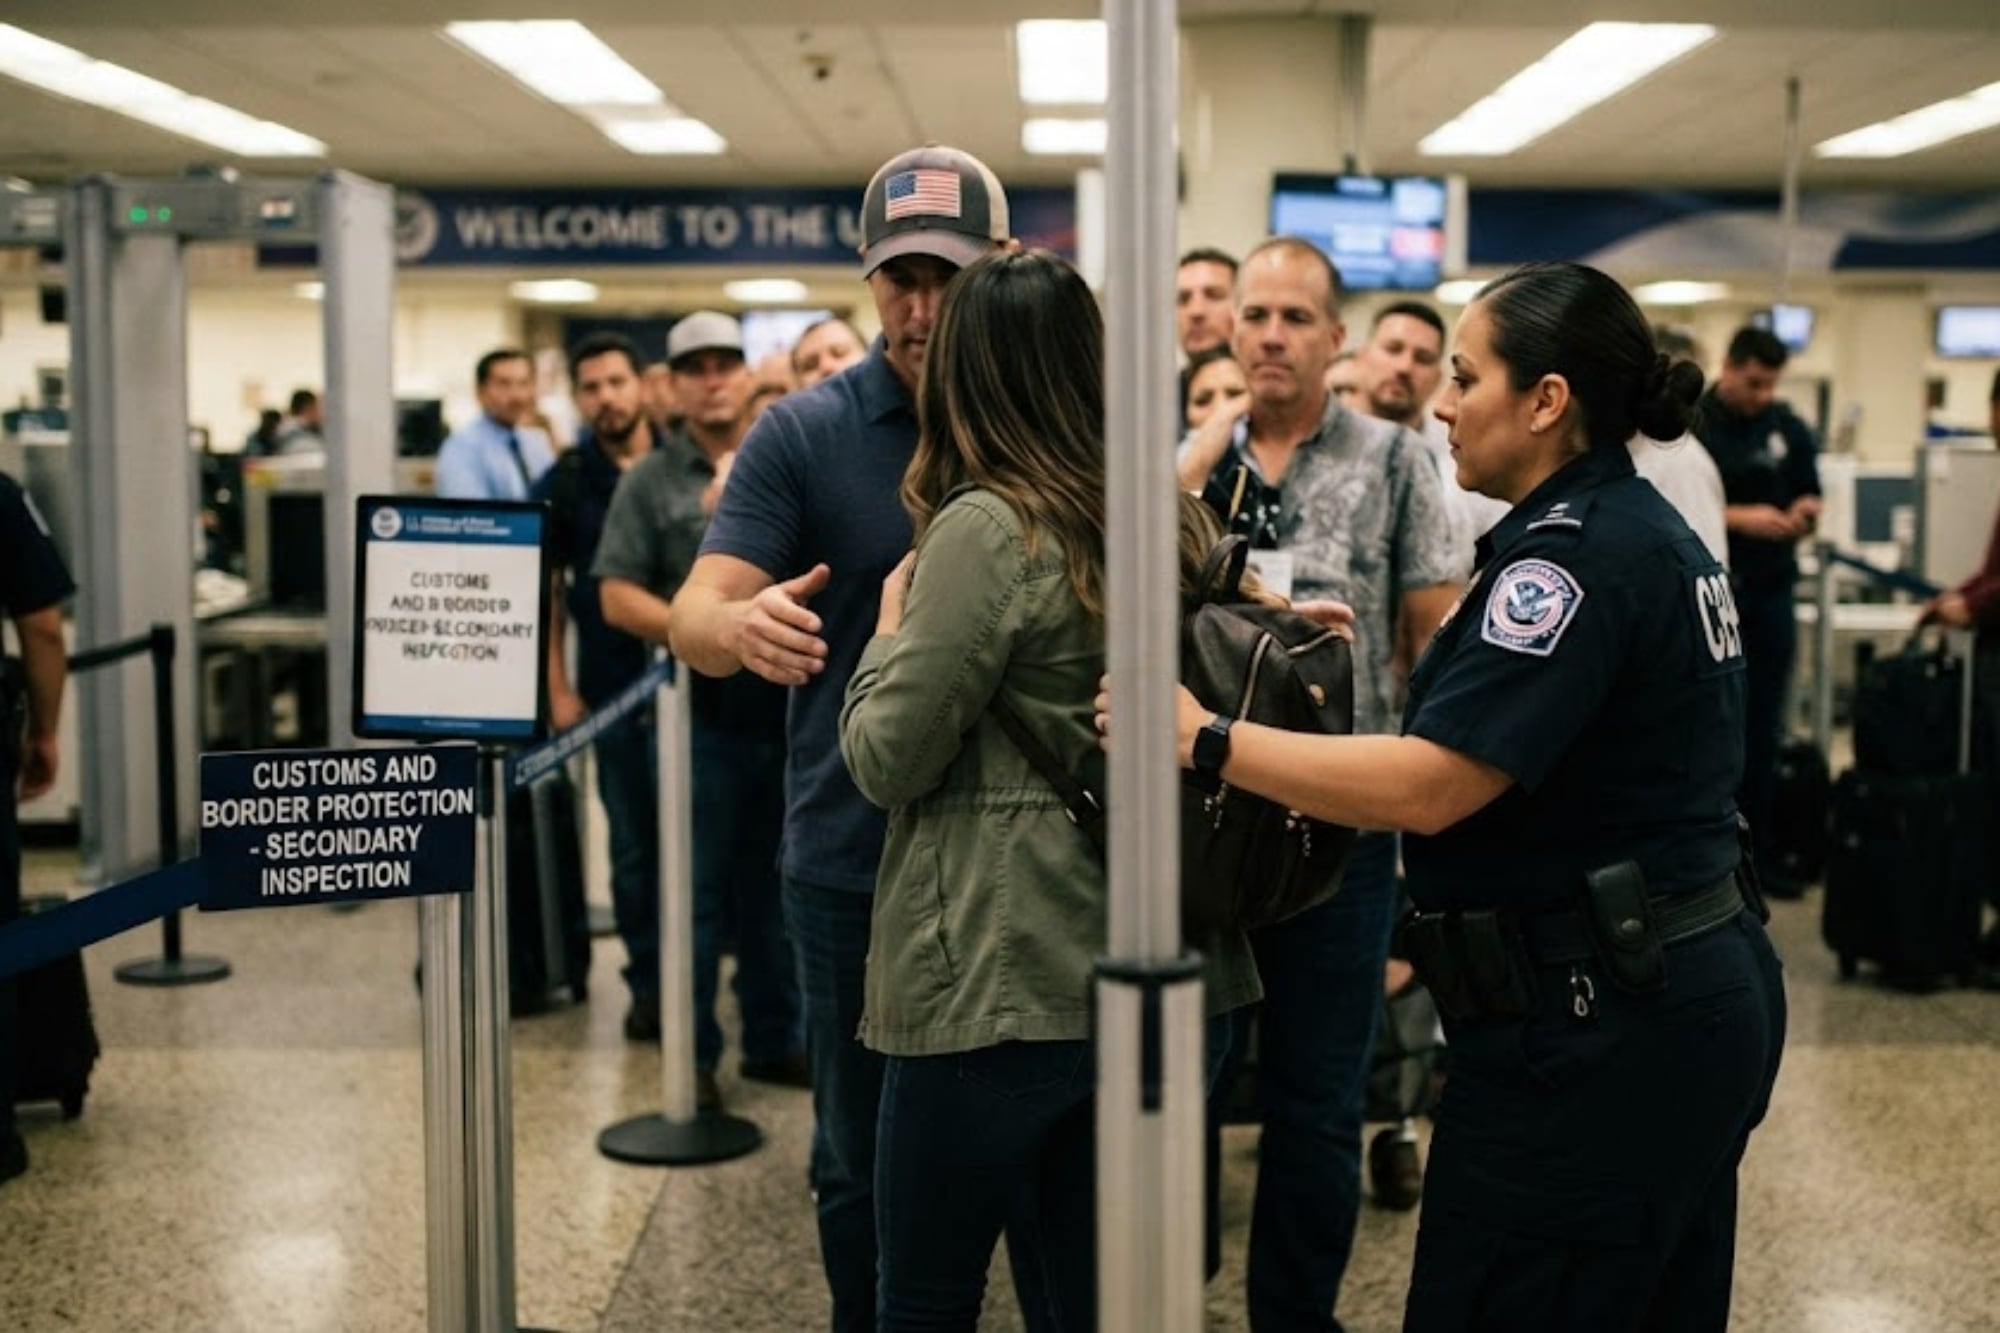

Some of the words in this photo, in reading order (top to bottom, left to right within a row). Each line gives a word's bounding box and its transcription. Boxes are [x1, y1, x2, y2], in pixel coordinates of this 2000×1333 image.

[455, 204, 667, 250] WELCOME
[680, 205, 739, 248] TO
[747, 206, 832, 249] THE
[253, 756, 377, 790] CUSTOMS
[383, 754, 437, 783] AND
[202, 796, 310, 828] BORDER
[317, 787, 474, 822] PROTECTION
[266, 823, 423, 860] SECONDARY
[261, 860, 412, 897] INSPECTION
